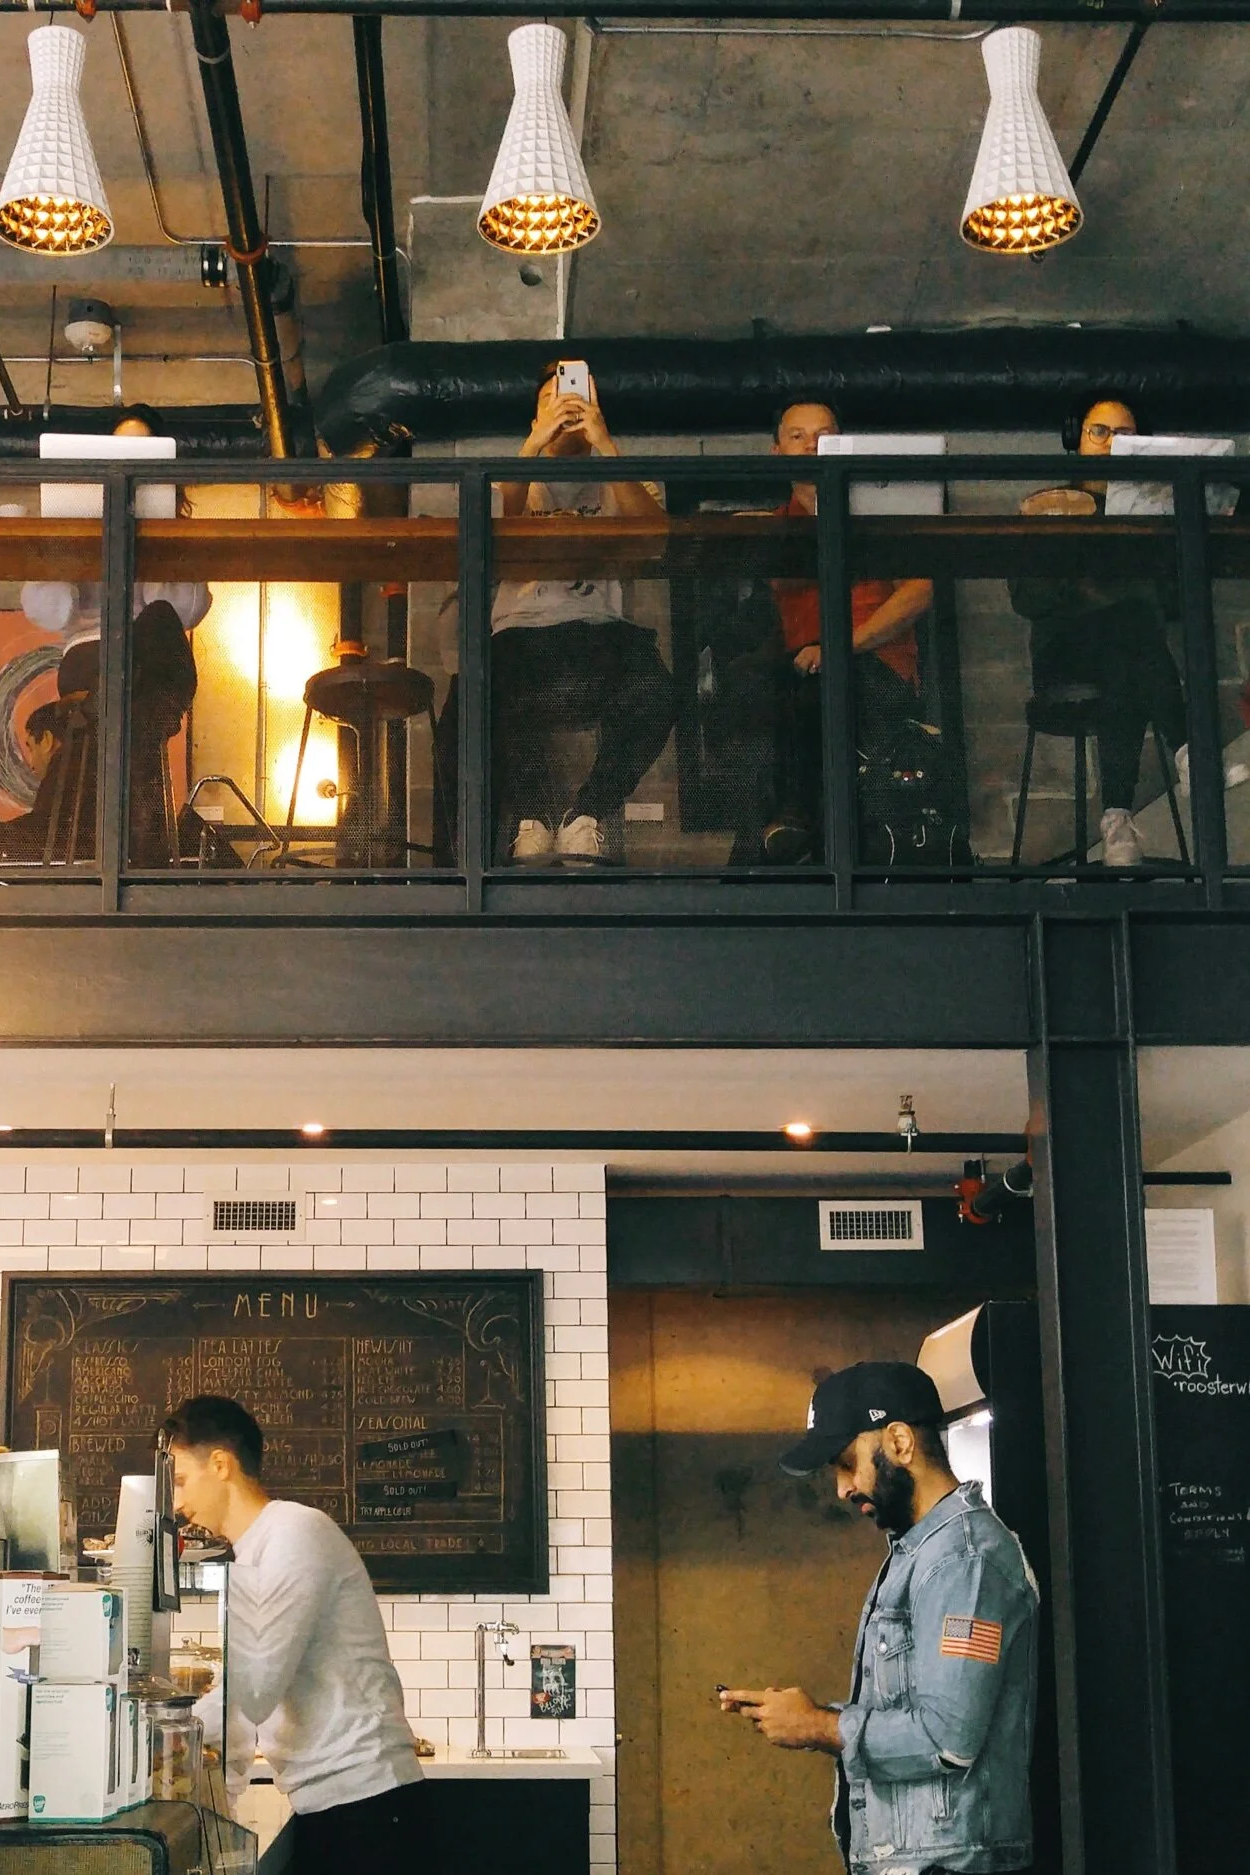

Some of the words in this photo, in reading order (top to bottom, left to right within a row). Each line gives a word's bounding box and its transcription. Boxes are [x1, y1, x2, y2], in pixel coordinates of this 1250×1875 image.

[233, 1292, 318, 1318] MENU
[73, 1340, 139, 1354] CLASSICS
[202, 1340, 227, 1354] TEA
[232, 1340, 282, 1354] LATTES
[75, 1357, 128, 1367] ESPRESSO
[203, 1357, 251, 1368] LONDON
[257, 1357, 282, 1368] FOG
[1151, 1344, 1202, 1372] Wifi
[75, 1367, 131, 1377] AMERICANO
[1179, 1373, 1250, 1395] roosterw
[75, 1405, 122, 1415] REGULAR
[125, 1405, 157, 1415] LATTE
[84, 1416, 114, 1427] SHOT
[357, 1415, 428, 1430] SEASONAL
[387, 1442, 409, 1453] SOLD
[383, 1485, 405, 1496] SOLD
[380, 1538, 417, 1550] LOCAL
[14, 1594, 42, 1604] coffee
[6, 1605, 22, 1616] I've
